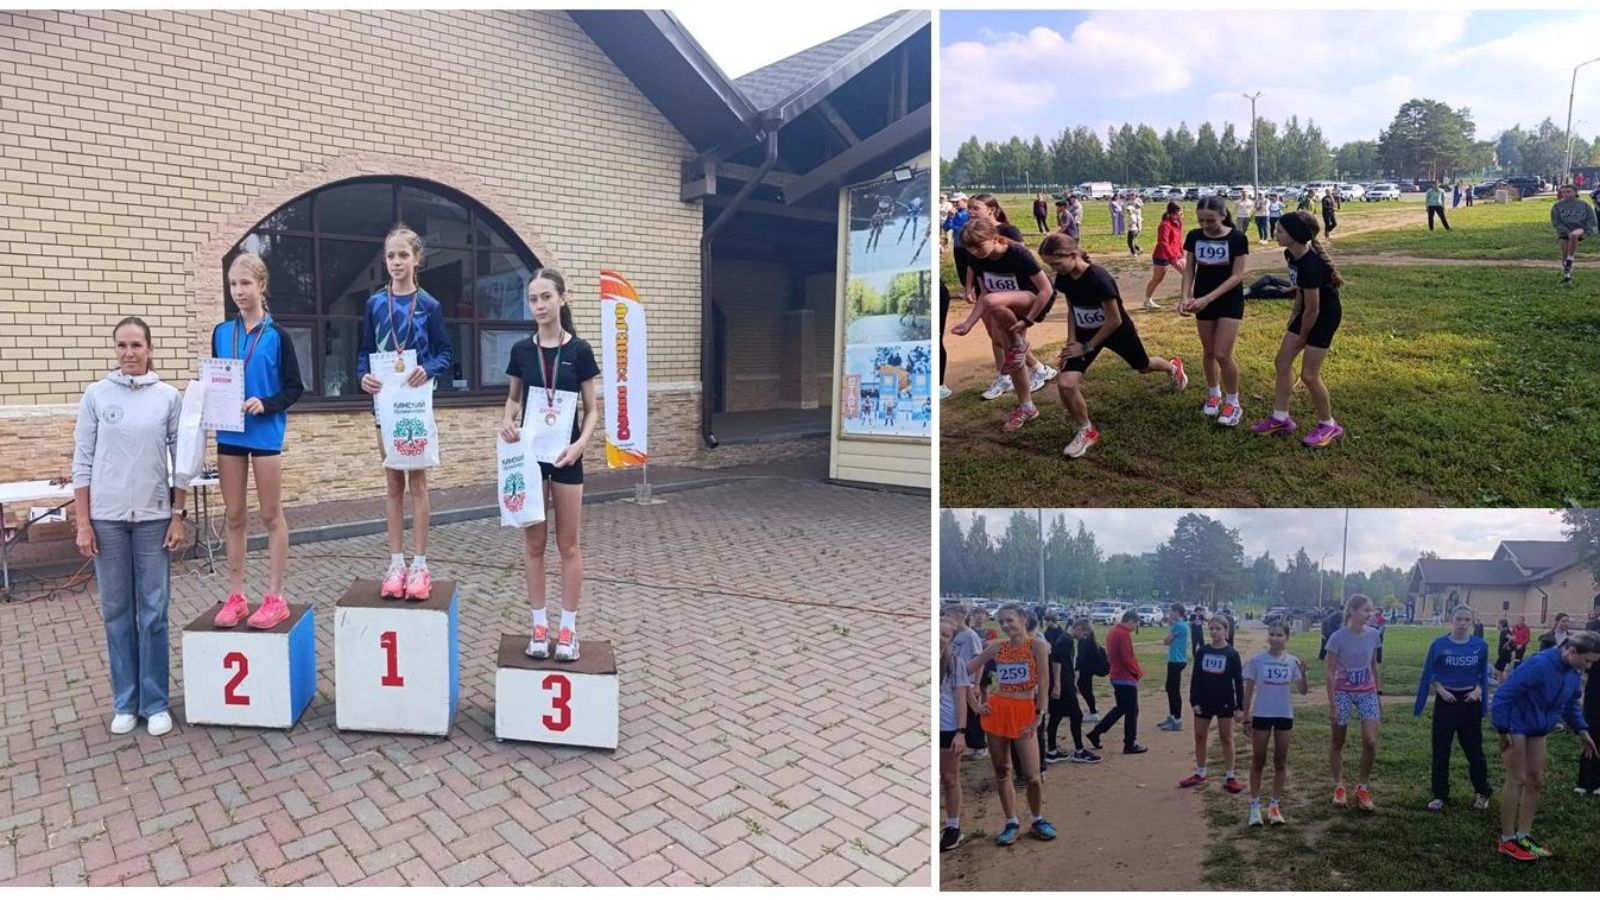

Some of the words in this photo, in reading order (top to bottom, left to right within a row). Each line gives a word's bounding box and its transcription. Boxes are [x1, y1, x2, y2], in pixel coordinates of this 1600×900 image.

[1199, 246, 1226, 259] 199
[987, 278, 1016, 291] 168
[1077, 310, 1105, 324] 166
[380, 631, 405, 687] 1
[1205, 658, 1223, 669] 191
[1446, 655, 1479, 666] RUSSIA
[223, 651, 250, 706] 2
[999, 666, 1027, 680] 259
[1266, 668, 1289, 680] 197
[542, 674, 572, 732] 3
